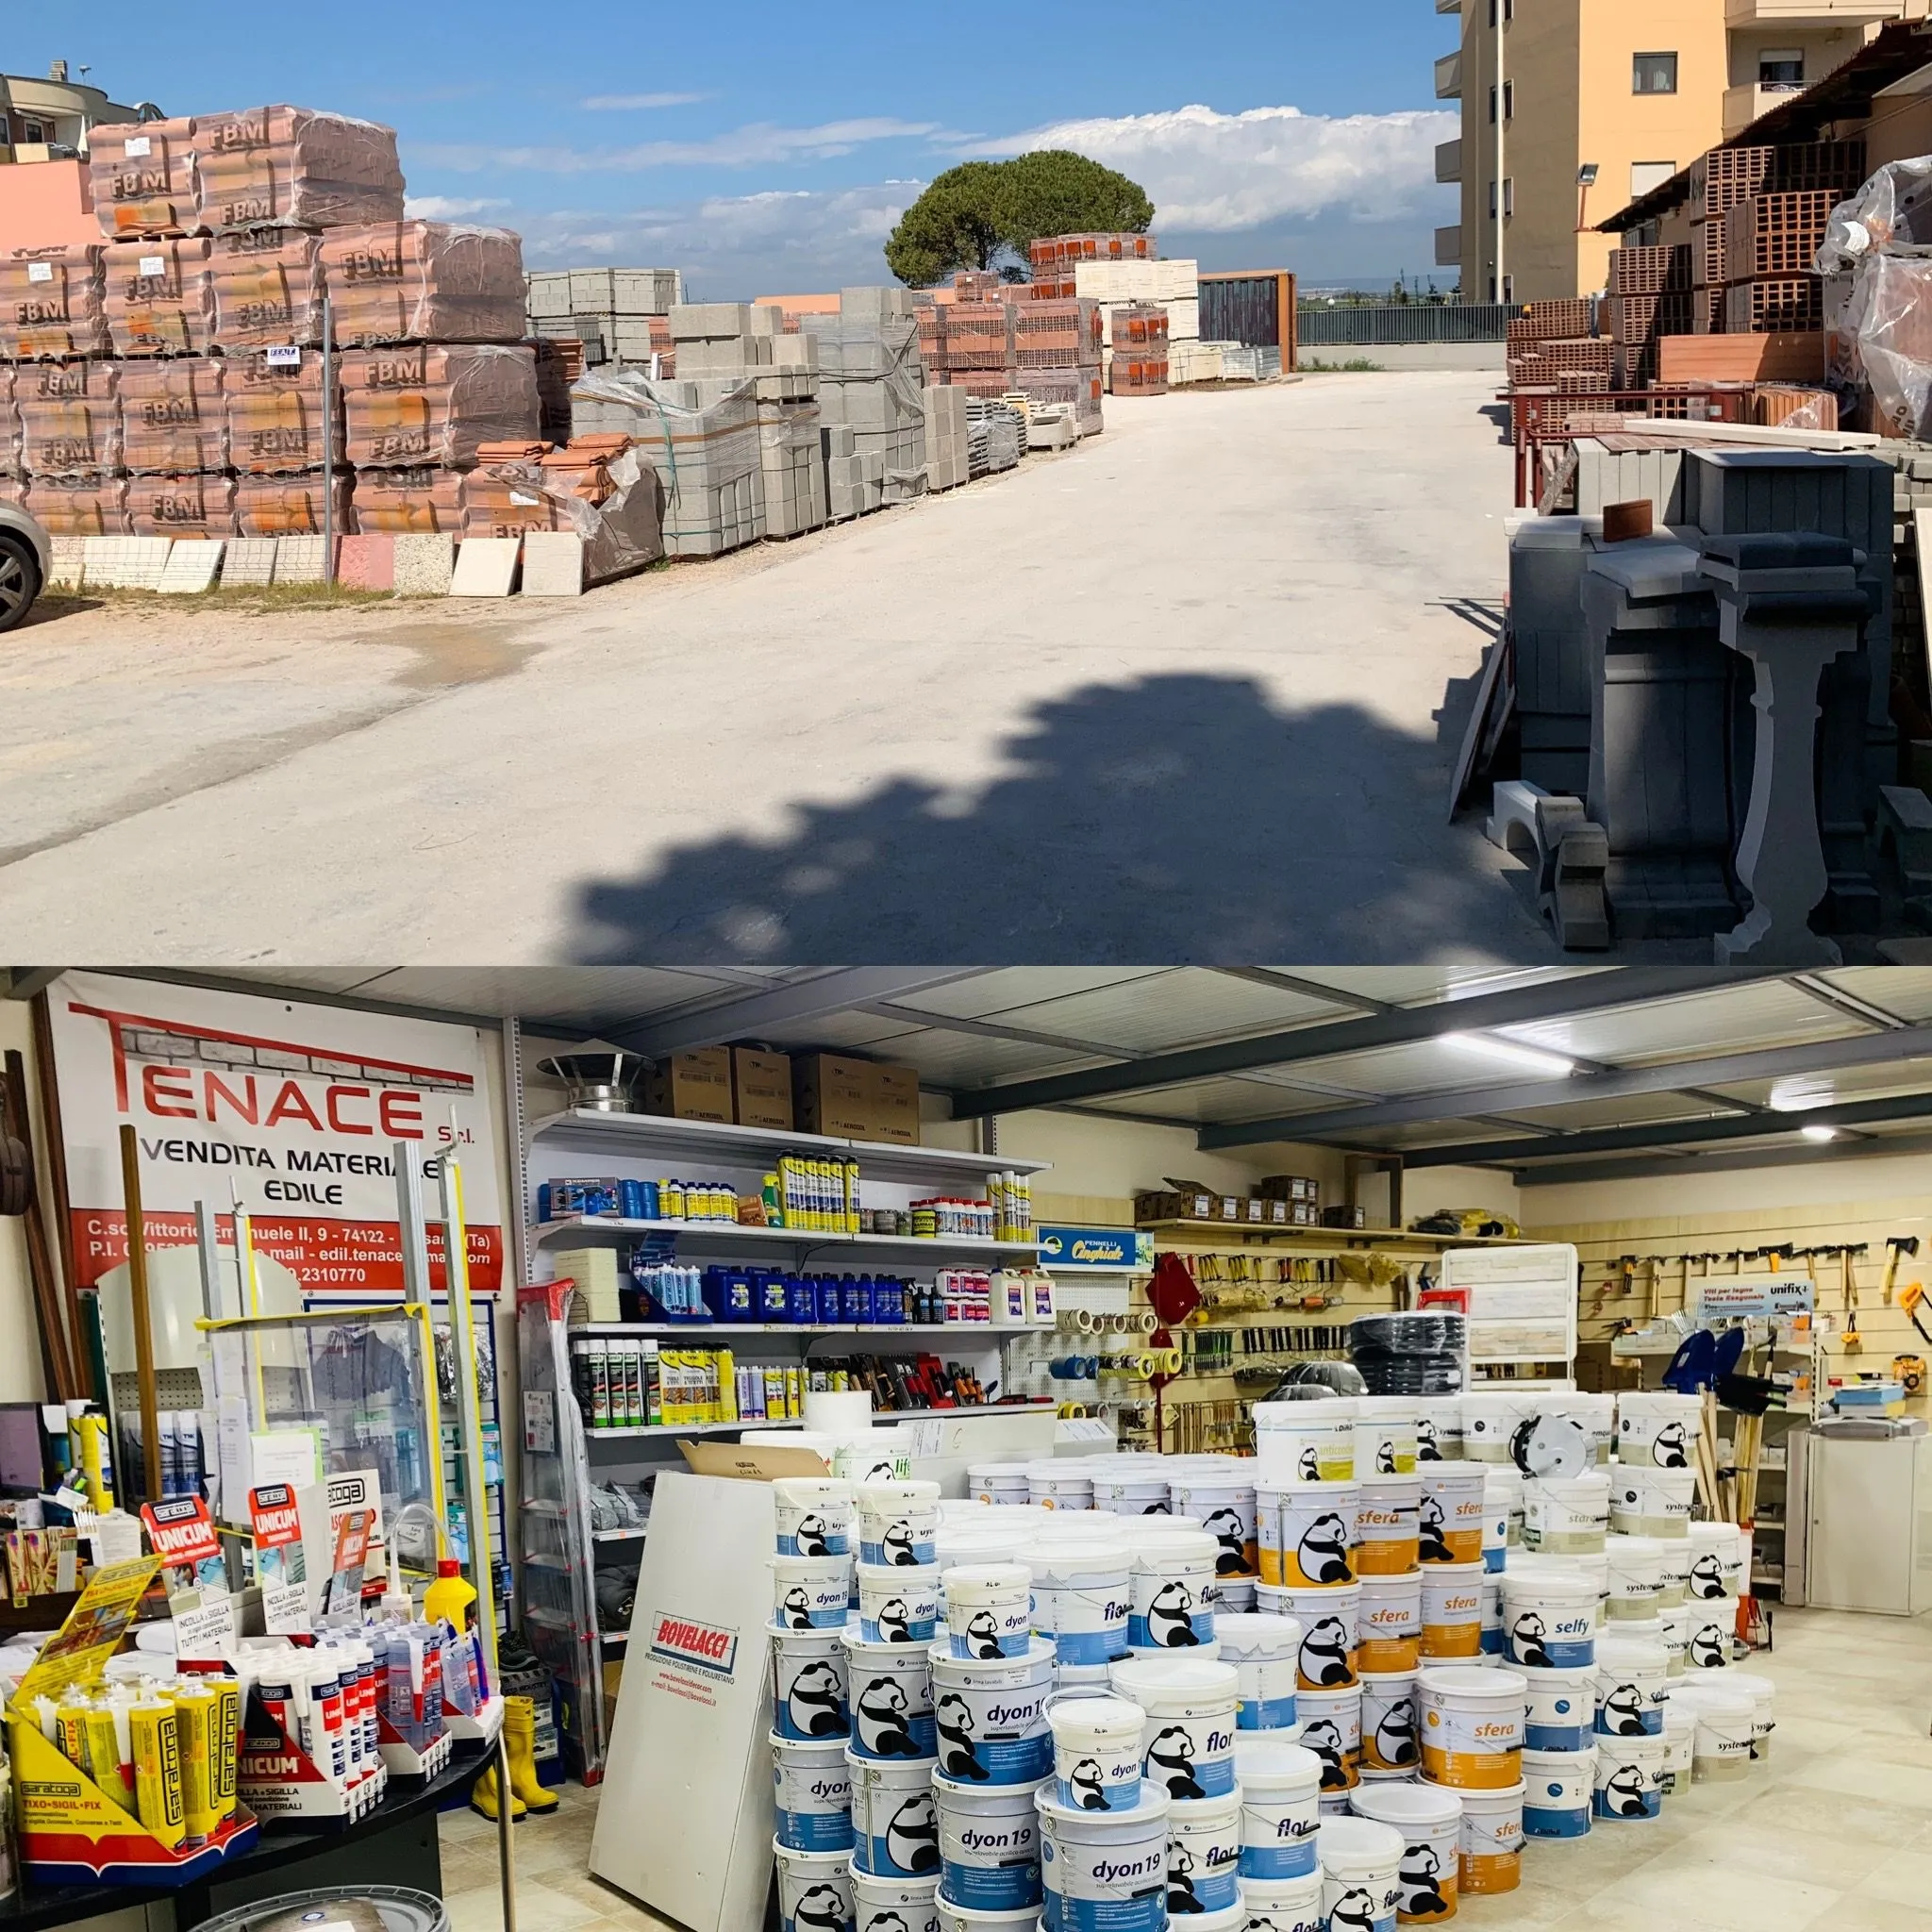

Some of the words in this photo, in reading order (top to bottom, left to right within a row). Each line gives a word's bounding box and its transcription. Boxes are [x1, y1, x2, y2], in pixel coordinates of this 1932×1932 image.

[210, 120, 269, 151] FBM
[109, 171, 172, 197] FBM
[220, 199, 275, 225] FBM
[340, 248, 403, 280] FBM
[123, 275, 183, 301] FBM
[14, 301, 71, 324] FBM
[233, 299, 291, 328] FBM
[37, 370, 88, 396] FBM
[364, 358, 425, 388] FBM
[142, 397, 200, 425] FBM
[41, 439, 96, 466] FBM
[248, 428, 308, 456] FBM
[370, 432, 429, 458] FBM
[150, 495, 207, 521] FBM
[68, 1002, 424, 1140] TENACE
[140, 1138, 275, 1170] VENDITA
[287, 1149, 440, 1179] MATERIE
[264, 1179, 342, 1205] EDILE
[215, 1224, 293, 1241] Emnuele
[317, 1228, 327, 1241] 9
[341, 1228, 385, 1244] 74122
[465, 1233, 491, 1248] (Ta)
[91, 1241, 117, 1257] P.I.
[319, 1248, 490, 1265] edil.tenacemaom
[1072, 1240, 1124, 1263] Cinghiale
[1770, 1282, 1803, 1295] unifix
[255, 1508, 299, 1534] UNICUM
[1358, 1510, 1400, 1524] sfera
[154, 1521, 213, 1552] UNICUM
[817, 1593, 841, 1606] dyon
[915, 1603, 934, 1617] dyon
[1445, 1596, 1477, 1609] sfera
[178, 1610, 204, 1628] INCOLLA
[208, 1606, 229, 1620] SIGILLA
[1006, 1615, 1026, 1629] dyon
[1371, 1608, 1409, 1623] sfera
[1555, 1618, 1590, 1635] selfy
[181, 1634, 198, 1649] TUTTI
[203, 1624, 233, 1644] MATERIALI
[657, 1619, 729, 1658] BOVELACCI
[644, 1653, 672, 1667] PRODUZIONE
[672, 1659, 698, 1675] POLISTIRENE
[702, 1669, 735, 1685] POLIURETANO
[987, 1705, 1032, 1725] dyon
[1208, 1732, 1233, 1752] flor
[1474, 1723, 1514, 1737] sfera
[164, 1721, 183, 1822] saratoga
[1111, 1762, 1136, 1778] dyon
[22, 1782, 79, 1796] saratoga
[266, 1787, 299, 1796] SIGILLA
[257, 1803, 302, 1811] MATERIALI
[961, 1829, 1008, 1850] dyon
[1011, 1828, 1031, 1845] 19
[1277, 1818, 1308, 1838] flor
[1092, 1860, 1143, 1882] dyon
[1145, 1853, 1160, 1873] 19
[1207, 1846, 1235, 1868] flor
